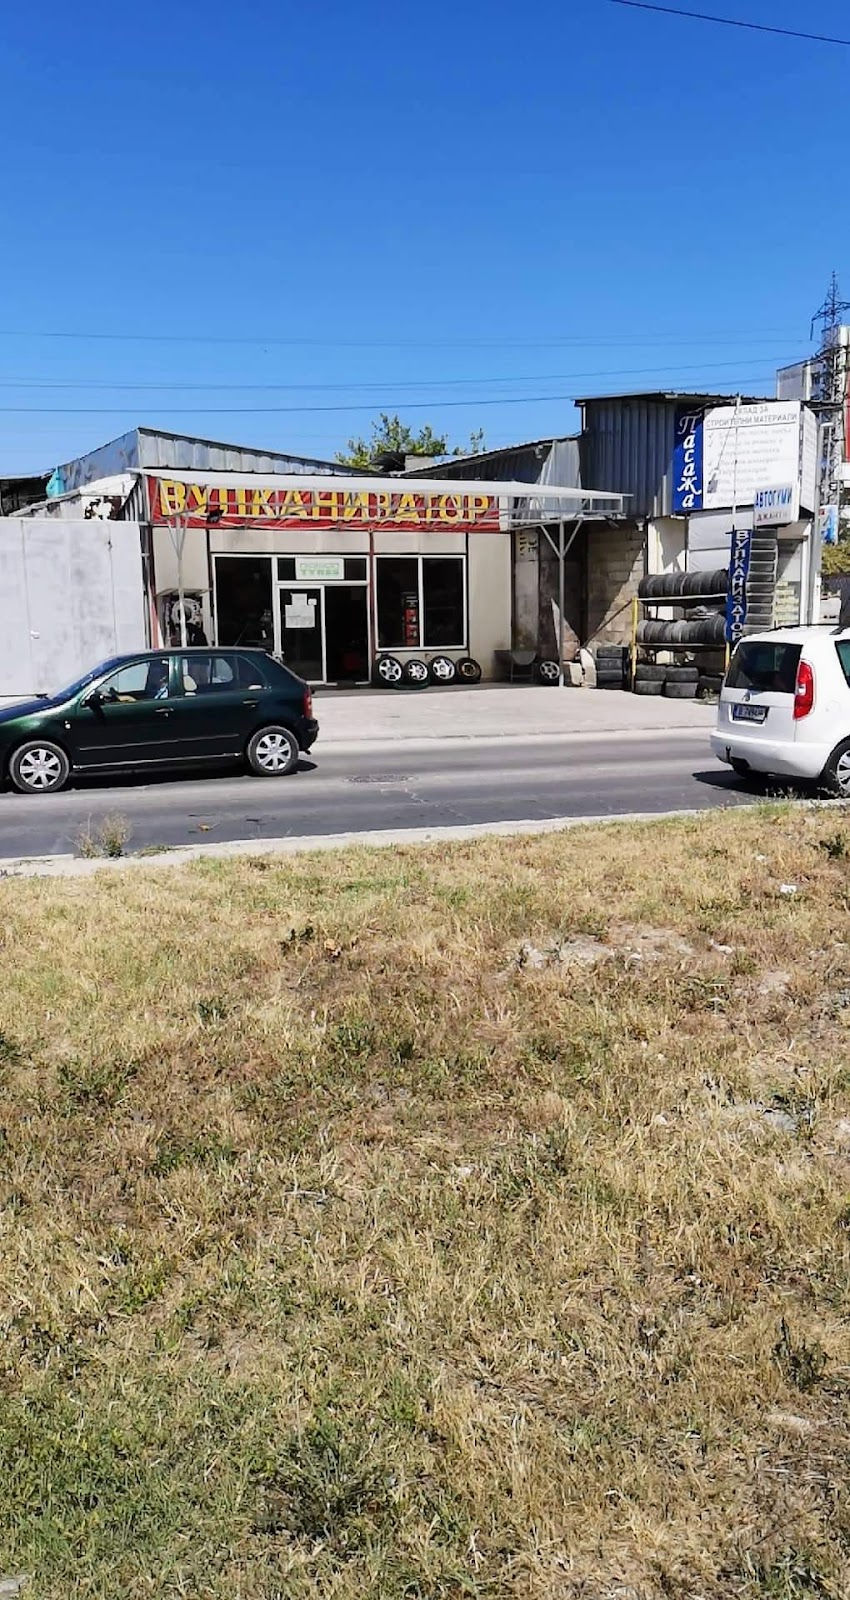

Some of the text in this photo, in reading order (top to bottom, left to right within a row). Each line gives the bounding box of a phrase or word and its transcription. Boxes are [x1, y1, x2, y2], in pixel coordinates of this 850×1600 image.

[753, 413, 798, 424] МАТЕРИАЛИ
[759, 405, 769, 414] ЗА
[677, 413, 702, 508] Пасажа
[160, 479, 491, 524] ВУЛКАНИЗАТОР
[755, 487, 793, 508] АВТОГУМИ
[730, 530, 749, 642] ВУЛКАНИЗАТОР
